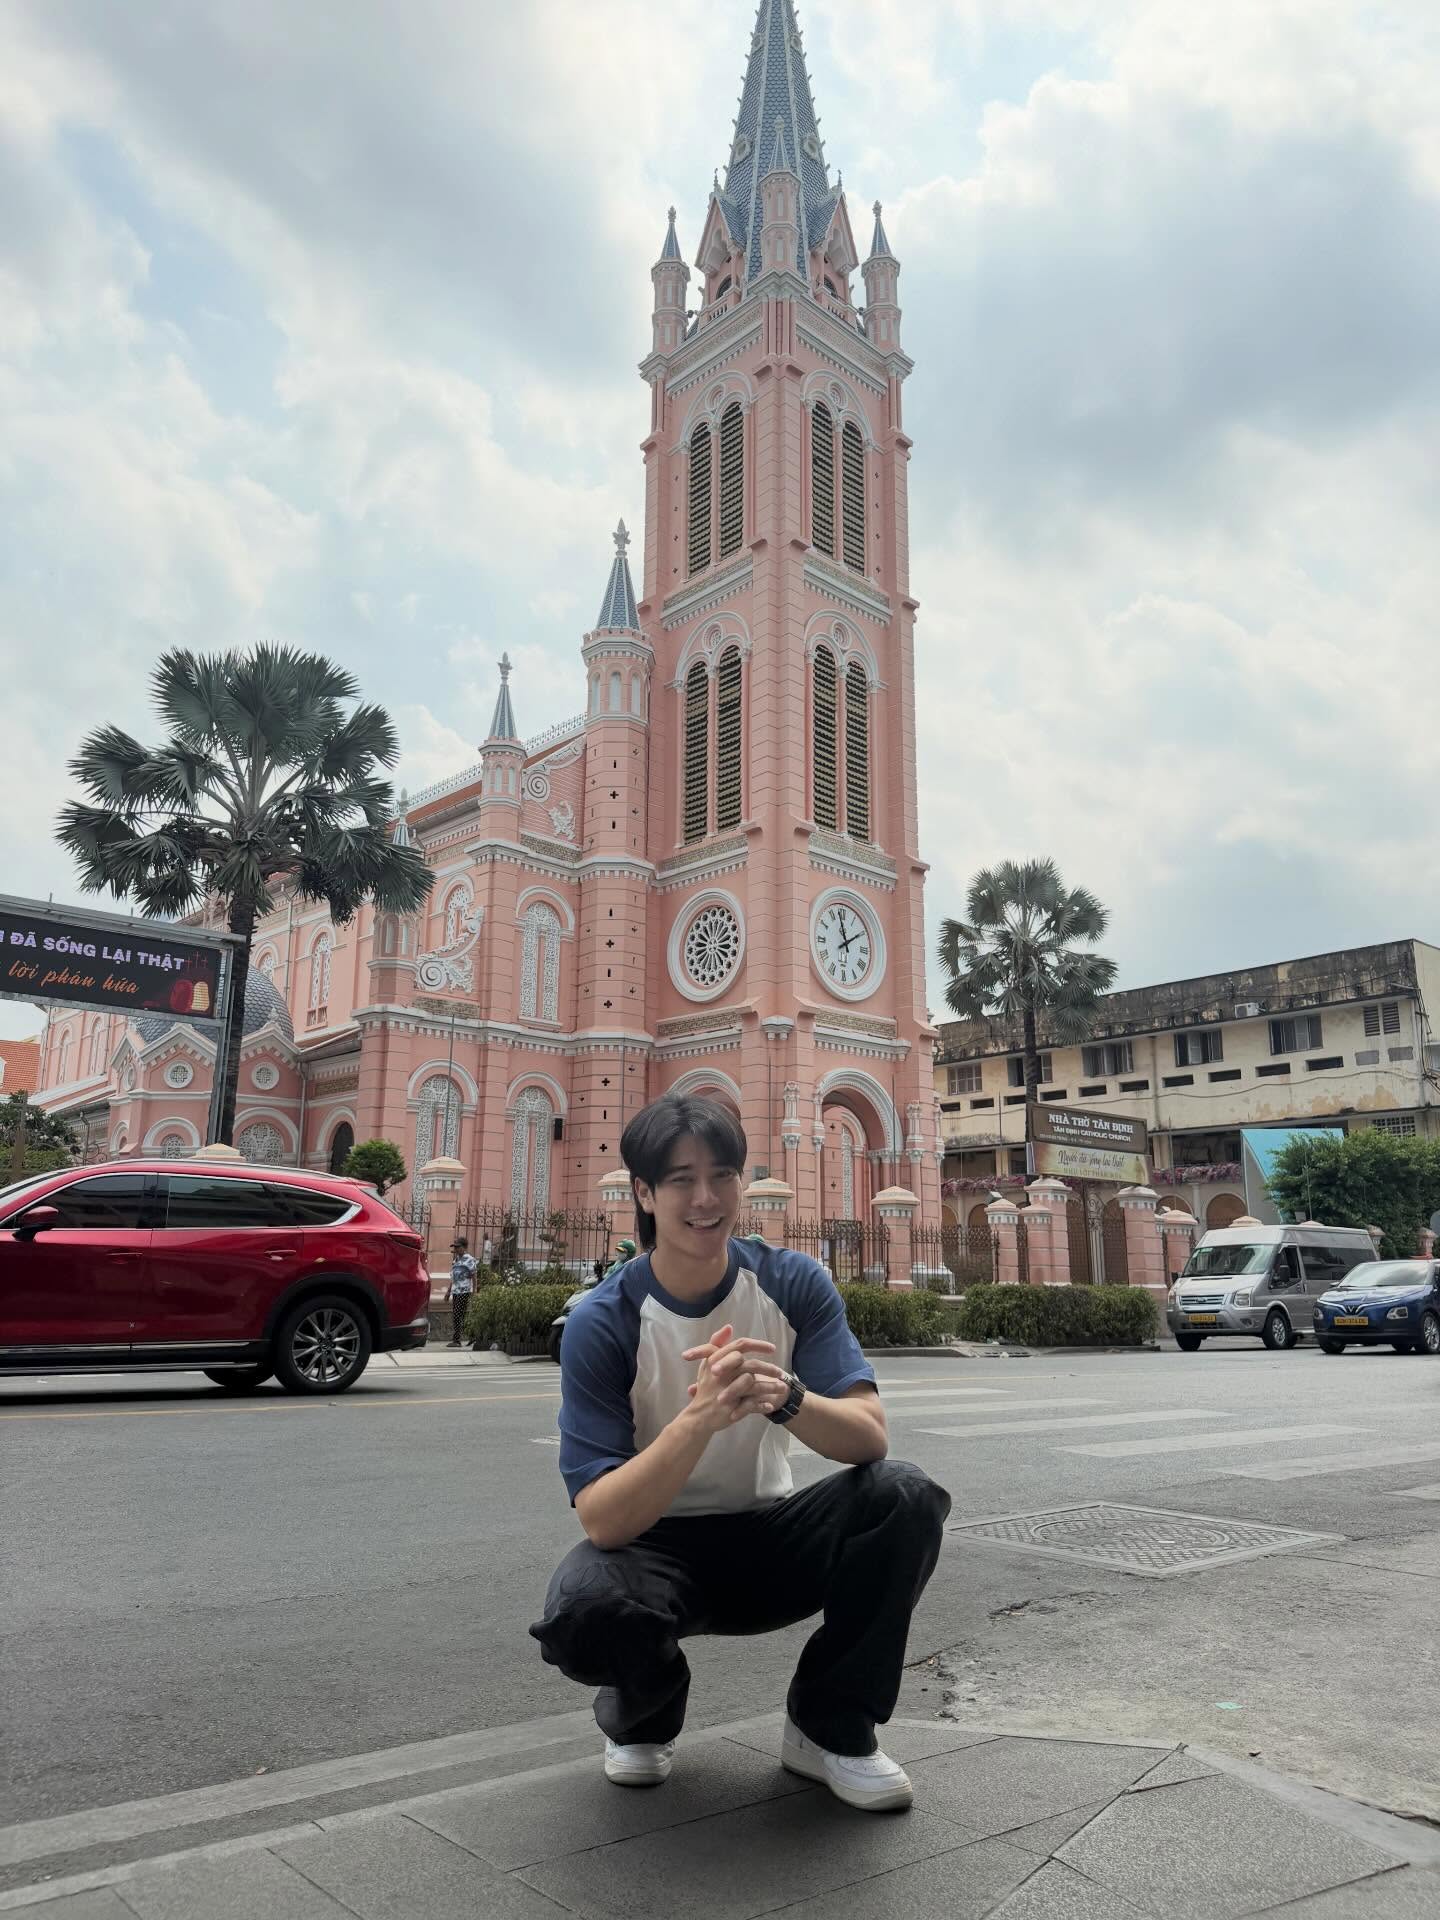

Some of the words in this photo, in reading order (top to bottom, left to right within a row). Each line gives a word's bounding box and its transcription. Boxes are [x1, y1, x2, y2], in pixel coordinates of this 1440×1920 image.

[10, 931, 37, 947] ĐÃ
[43, 935, 97, 958] SỐNG
[102, 946, 131, 965] LẠI
[137, 951, 185, 971] THẬT
[8, 959, 40, 980] lời
[1048, 1113, 1070, 1125] NHÀ
[1071, 1116, 1090, 1128] THỜ
[1092, 1119, 1110, 1130] TÂN
[1111, 1122, 1134, 1135] ĐỊNH
[1081, 1130, 1107, 1139] CATHOLIC
[1108, 1133, 1131, 1142] CHURCH
